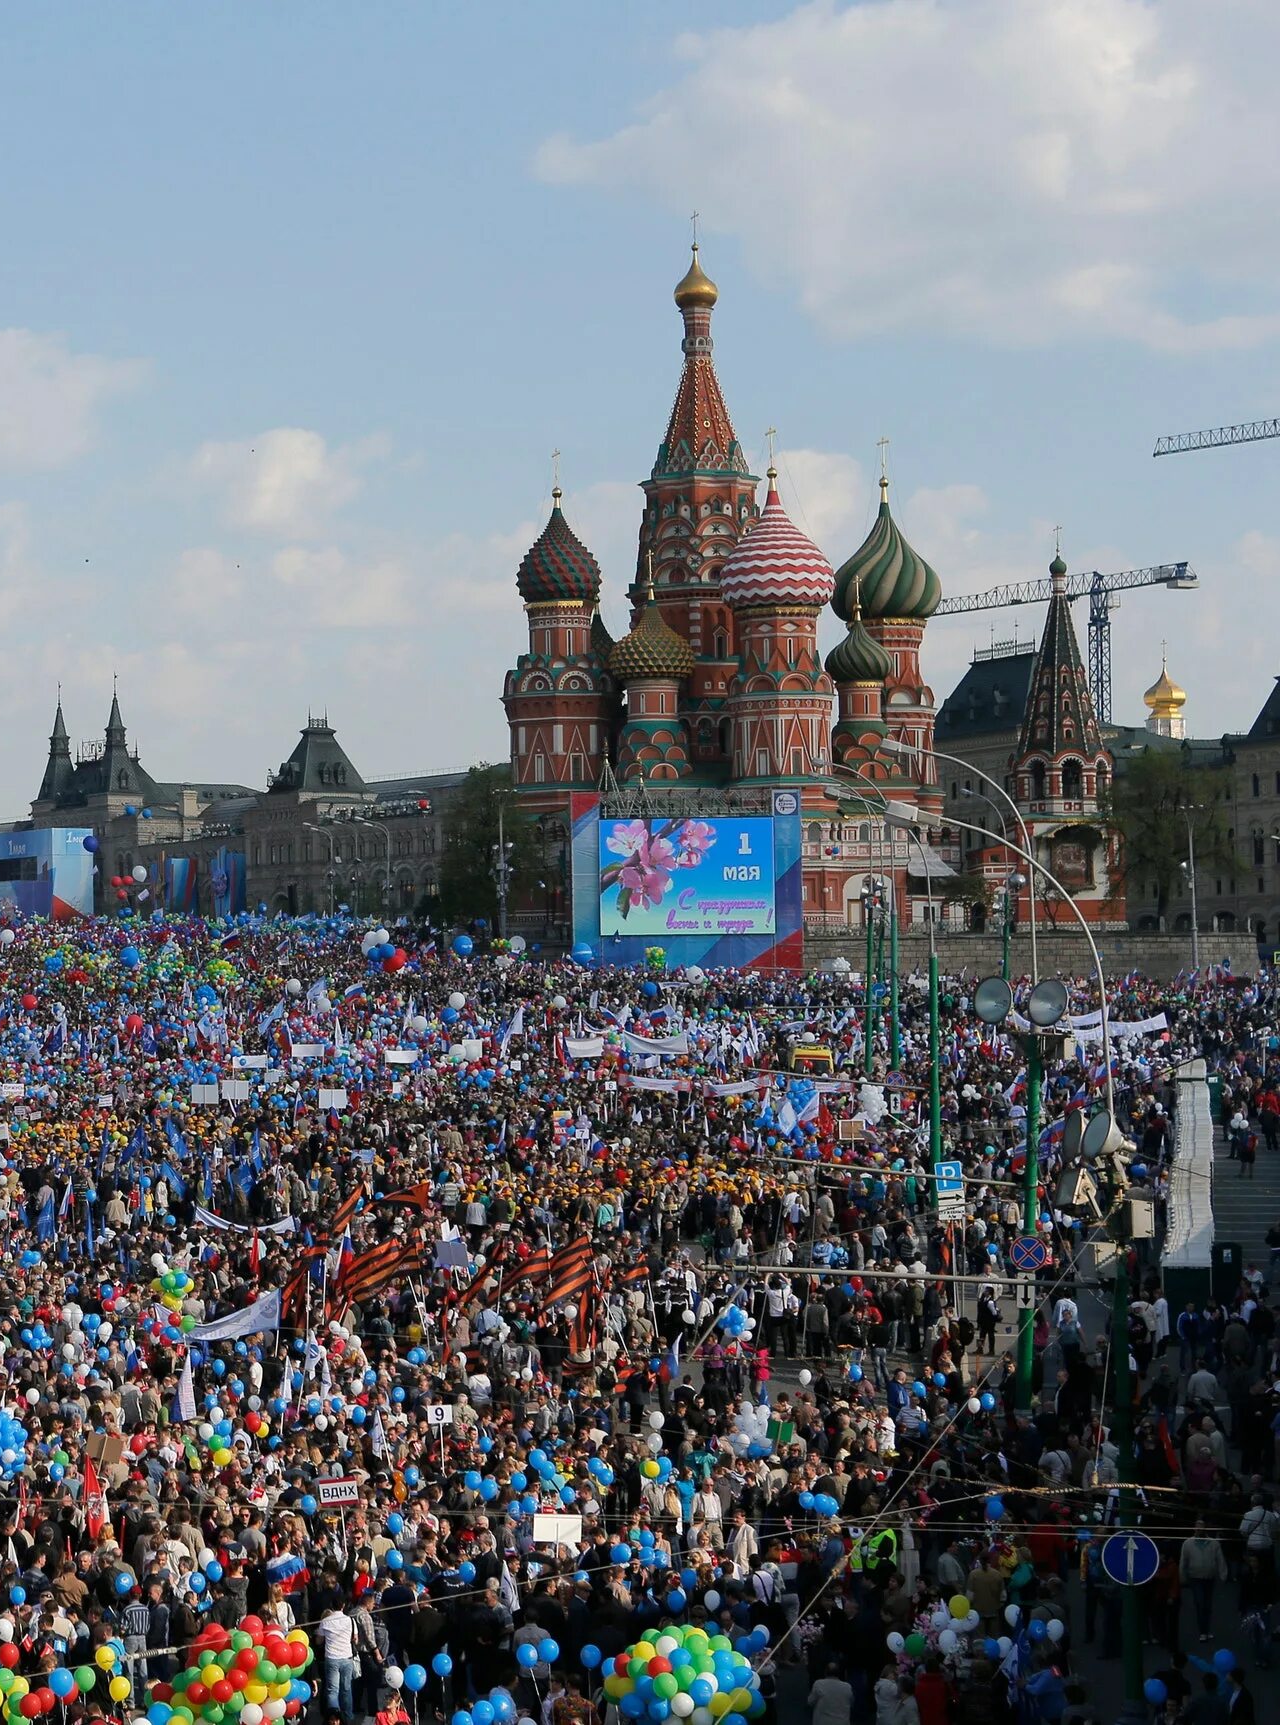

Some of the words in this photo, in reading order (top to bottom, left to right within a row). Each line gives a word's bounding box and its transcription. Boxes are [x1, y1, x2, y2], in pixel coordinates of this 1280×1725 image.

[738, 832, 752, 855] 1
[723, 866, 760, 881] мая
[679, 888, 696, 910] С
[942, 1166, 956, 1187] P
[434, 1407, 445, 1422] 9
[322, 1485, 356, 1499] ВДНХ
